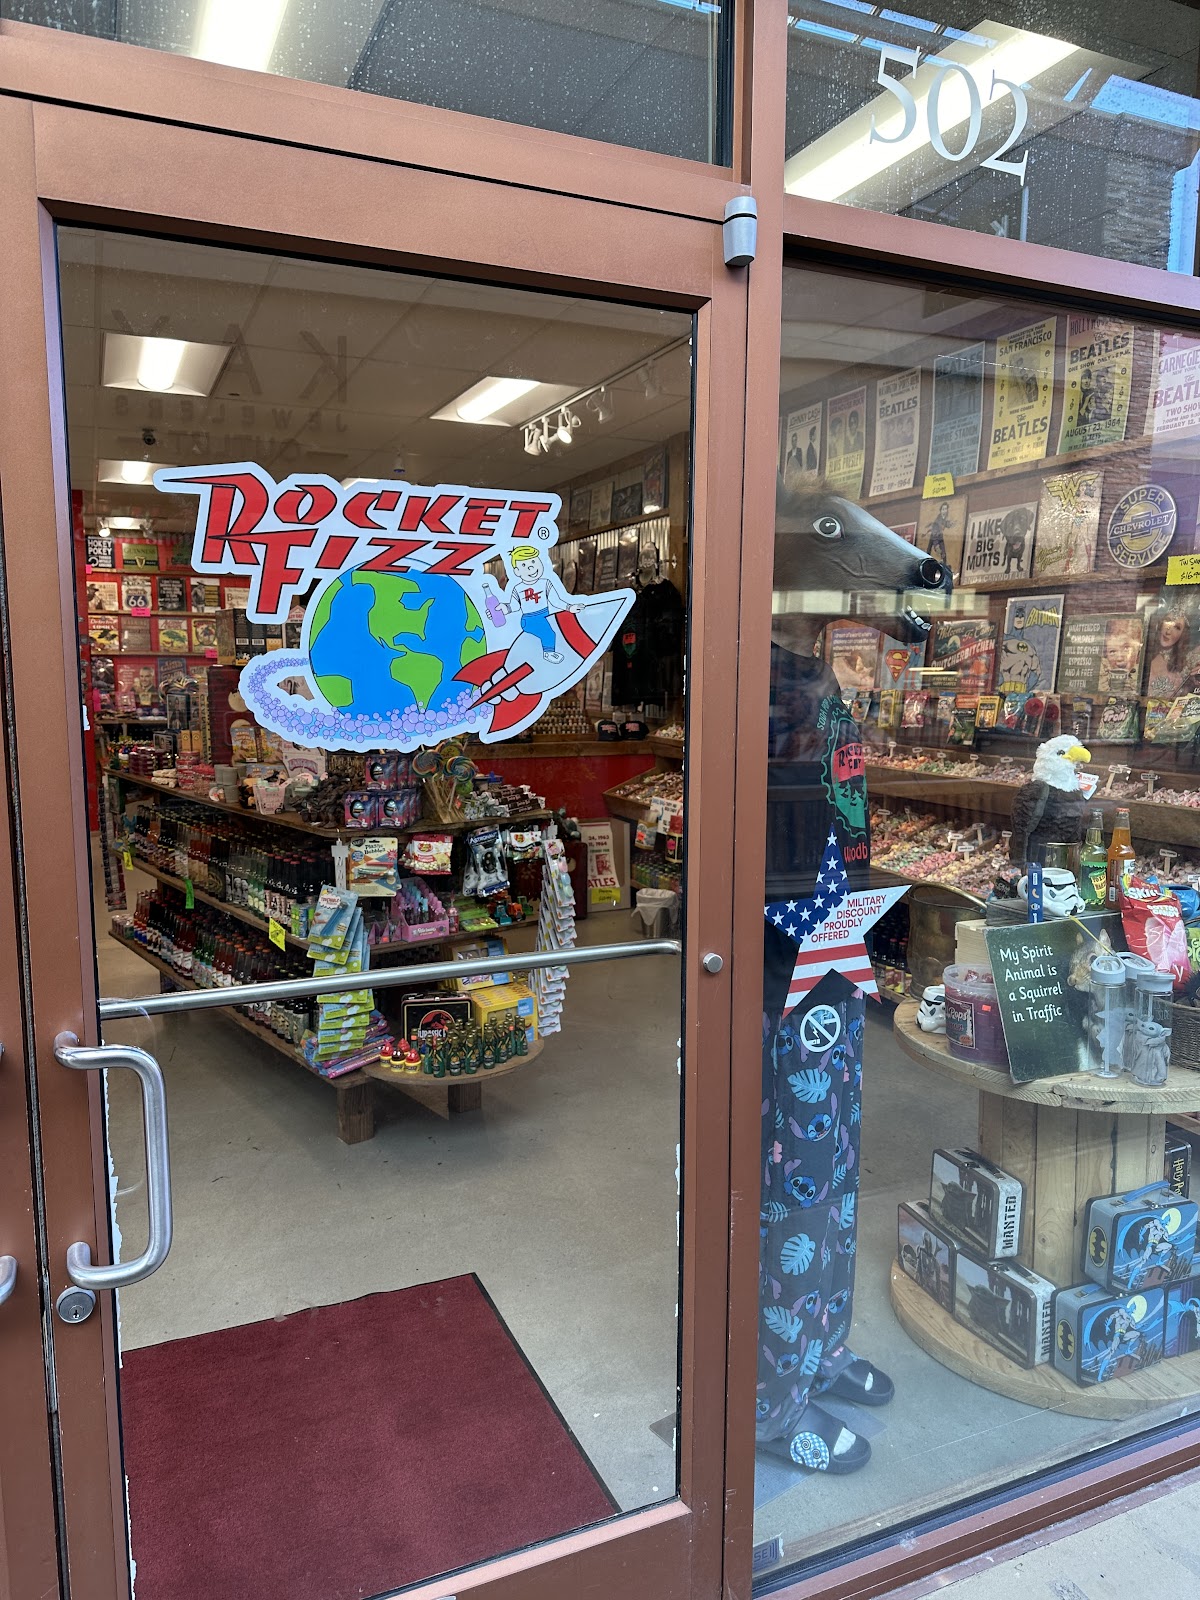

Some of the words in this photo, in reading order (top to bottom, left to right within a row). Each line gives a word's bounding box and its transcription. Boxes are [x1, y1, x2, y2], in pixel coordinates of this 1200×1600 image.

[869, 46, 1029, 186] 502
[999, 345, 1013, 357] SAN
[1014, 330, 1052, 352] FRANCISCO
[1070, 332, 1130, 364] BEATLES
[1080, 360, 1095, 369] SHOW
[1158, 349, 1200, 375] CARNEGIE
[1153, 380, 1200, 409] BEATL
[879, 396, 918, 418] BEATLES
[1166, 406, 1182, 417] TWO
[993, 416, 1048, 445] BEATLES
[1065, 426, 1092, 438] AUGUST
[1104, 417, 1121, 429] 1964
[1156, 420, 1186, 432] FEBRUARY
[842, 452, 863, 470] PRESLEY
[1120, 489, 1166, 512] SUPER
[163, 473, 552, 565] ROCKET
[970, 522, 977, 539] I
[978, 517, 1002, 538] LIKE
[1113, 514, 1169, 535] CHEVROLET
[88, 540, 112, 548] HOKEY
[88, 547, 112, 555] POKEY
[976, 539, 995, 553] BIG
[1113, 533, 1170, 566] SERVICE
[966, 551, 1001, 571] MUTTS
[208, 528, 496, 615] FIZZ
[128, 595, 146, 607] 66
[1026, 606, 1060, 629] BATMAN
[937, 626, 965, 640] Welcome
[1068, 623, 1100, 632] UNATTENDED
[1071, 635, 1096, 643] CHILDREN
[1084, 645, 1099, 654] GIVEN
[1068, 657, 1092, 666] ESPRESSO
[1064, 669, 1075, 677] AND
[1080, 668, 1093, 677] FREE
[817, 708, 828, 731] SODA
[1103, 709, 1129, 722] Trolli
[588, 877, 616, 888] ATLES
[847, 894, 888, 908] MILITARY
[836, 905, 882, 920] DISCOUNT
[823, 917, 864, 931] PROUDLY
[811, 929, 850, 943] OFFERED
[999, 946, 1020, 965] My
[1022, 944, 1054, 962] Spirit
[1004, 964, 1046, 983] Animal
[1047, 964, 1057, 977] is
[1008, 991, 1018, 1002] a
[1019, 983, 1063, 1004] Squirrel
[1012, 1010, 1025, 1023] in
[1026, 1005, 1063, 1023] Traffic
[1173, 1158, 1185, 1182] Harry
[1002, 1195, 1017, 1250] WANTED
